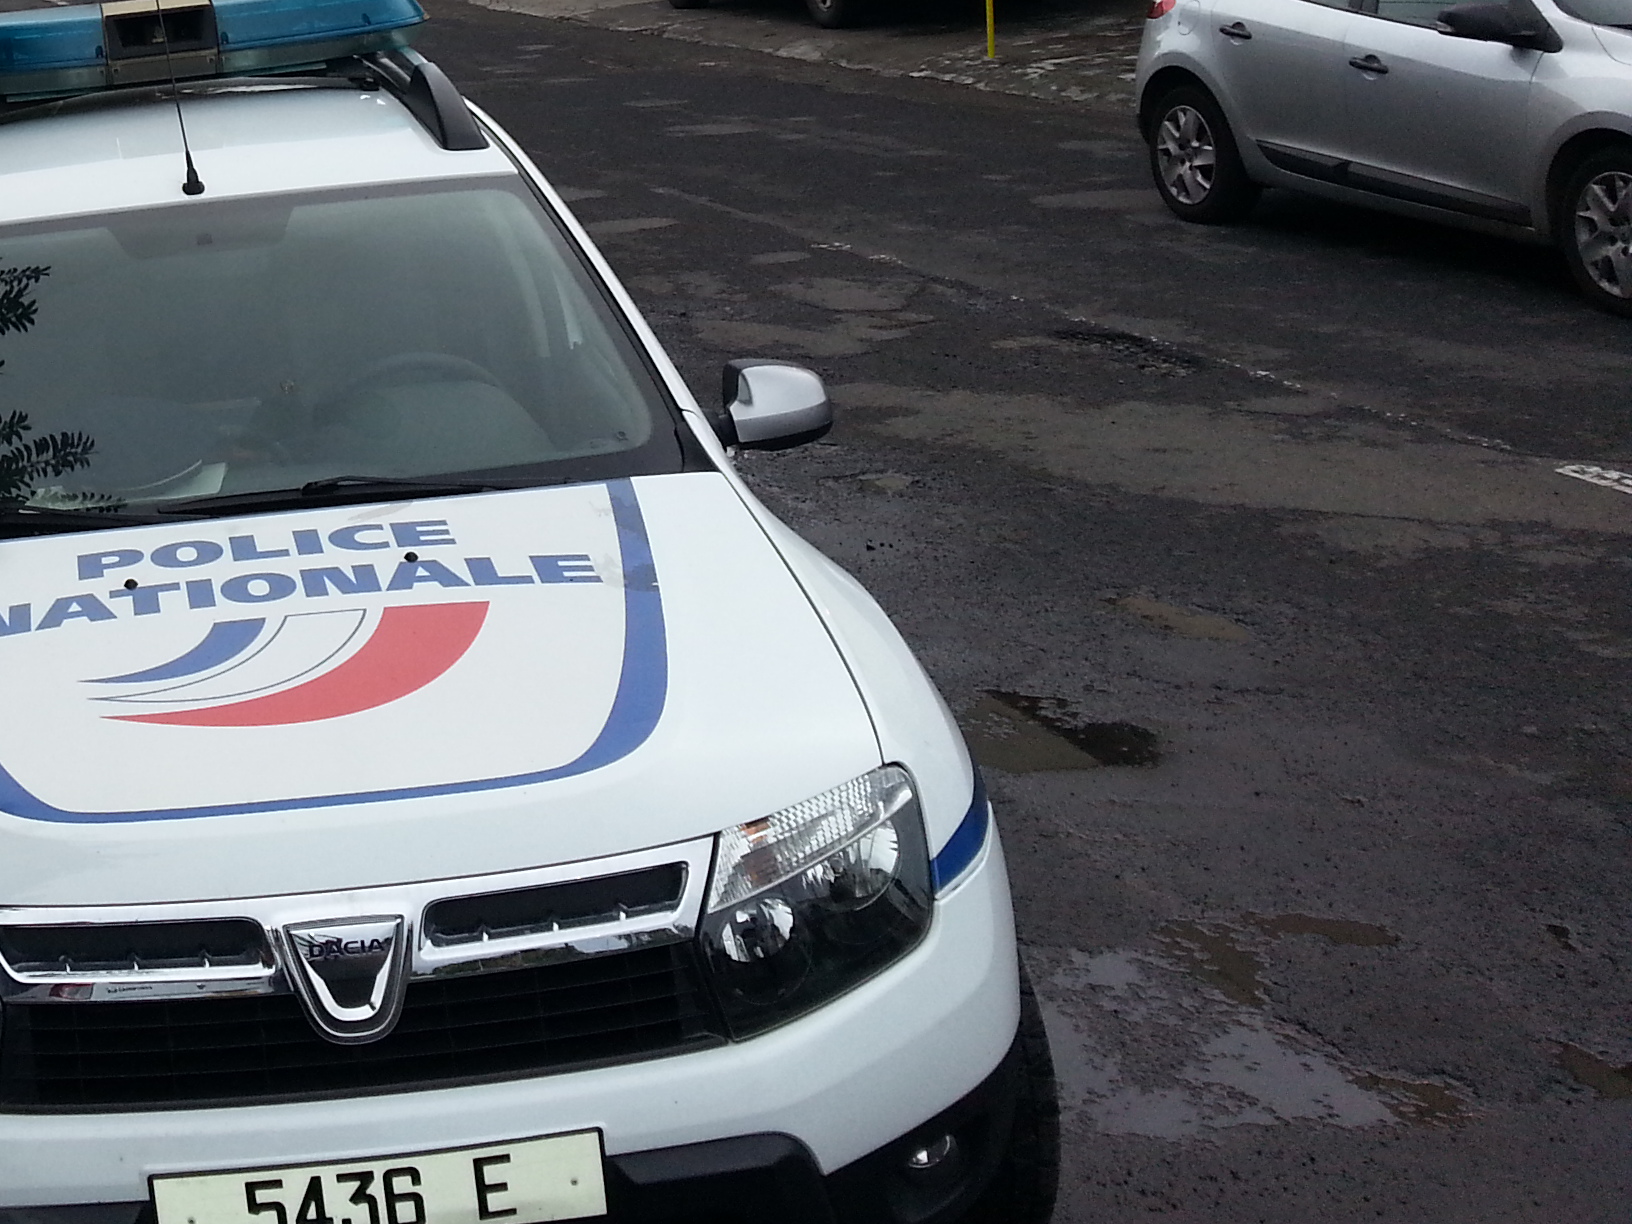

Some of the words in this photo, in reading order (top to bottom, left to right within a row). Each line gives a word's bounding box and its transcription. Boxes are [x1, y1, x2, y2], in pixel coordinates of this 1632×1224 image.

[77, 518, 457, 582] POLICE
[308, 937, 386, 960] DACIA
[244, 1166, 427, 1224] 5436
[472, 1152, 518, 1222] E
